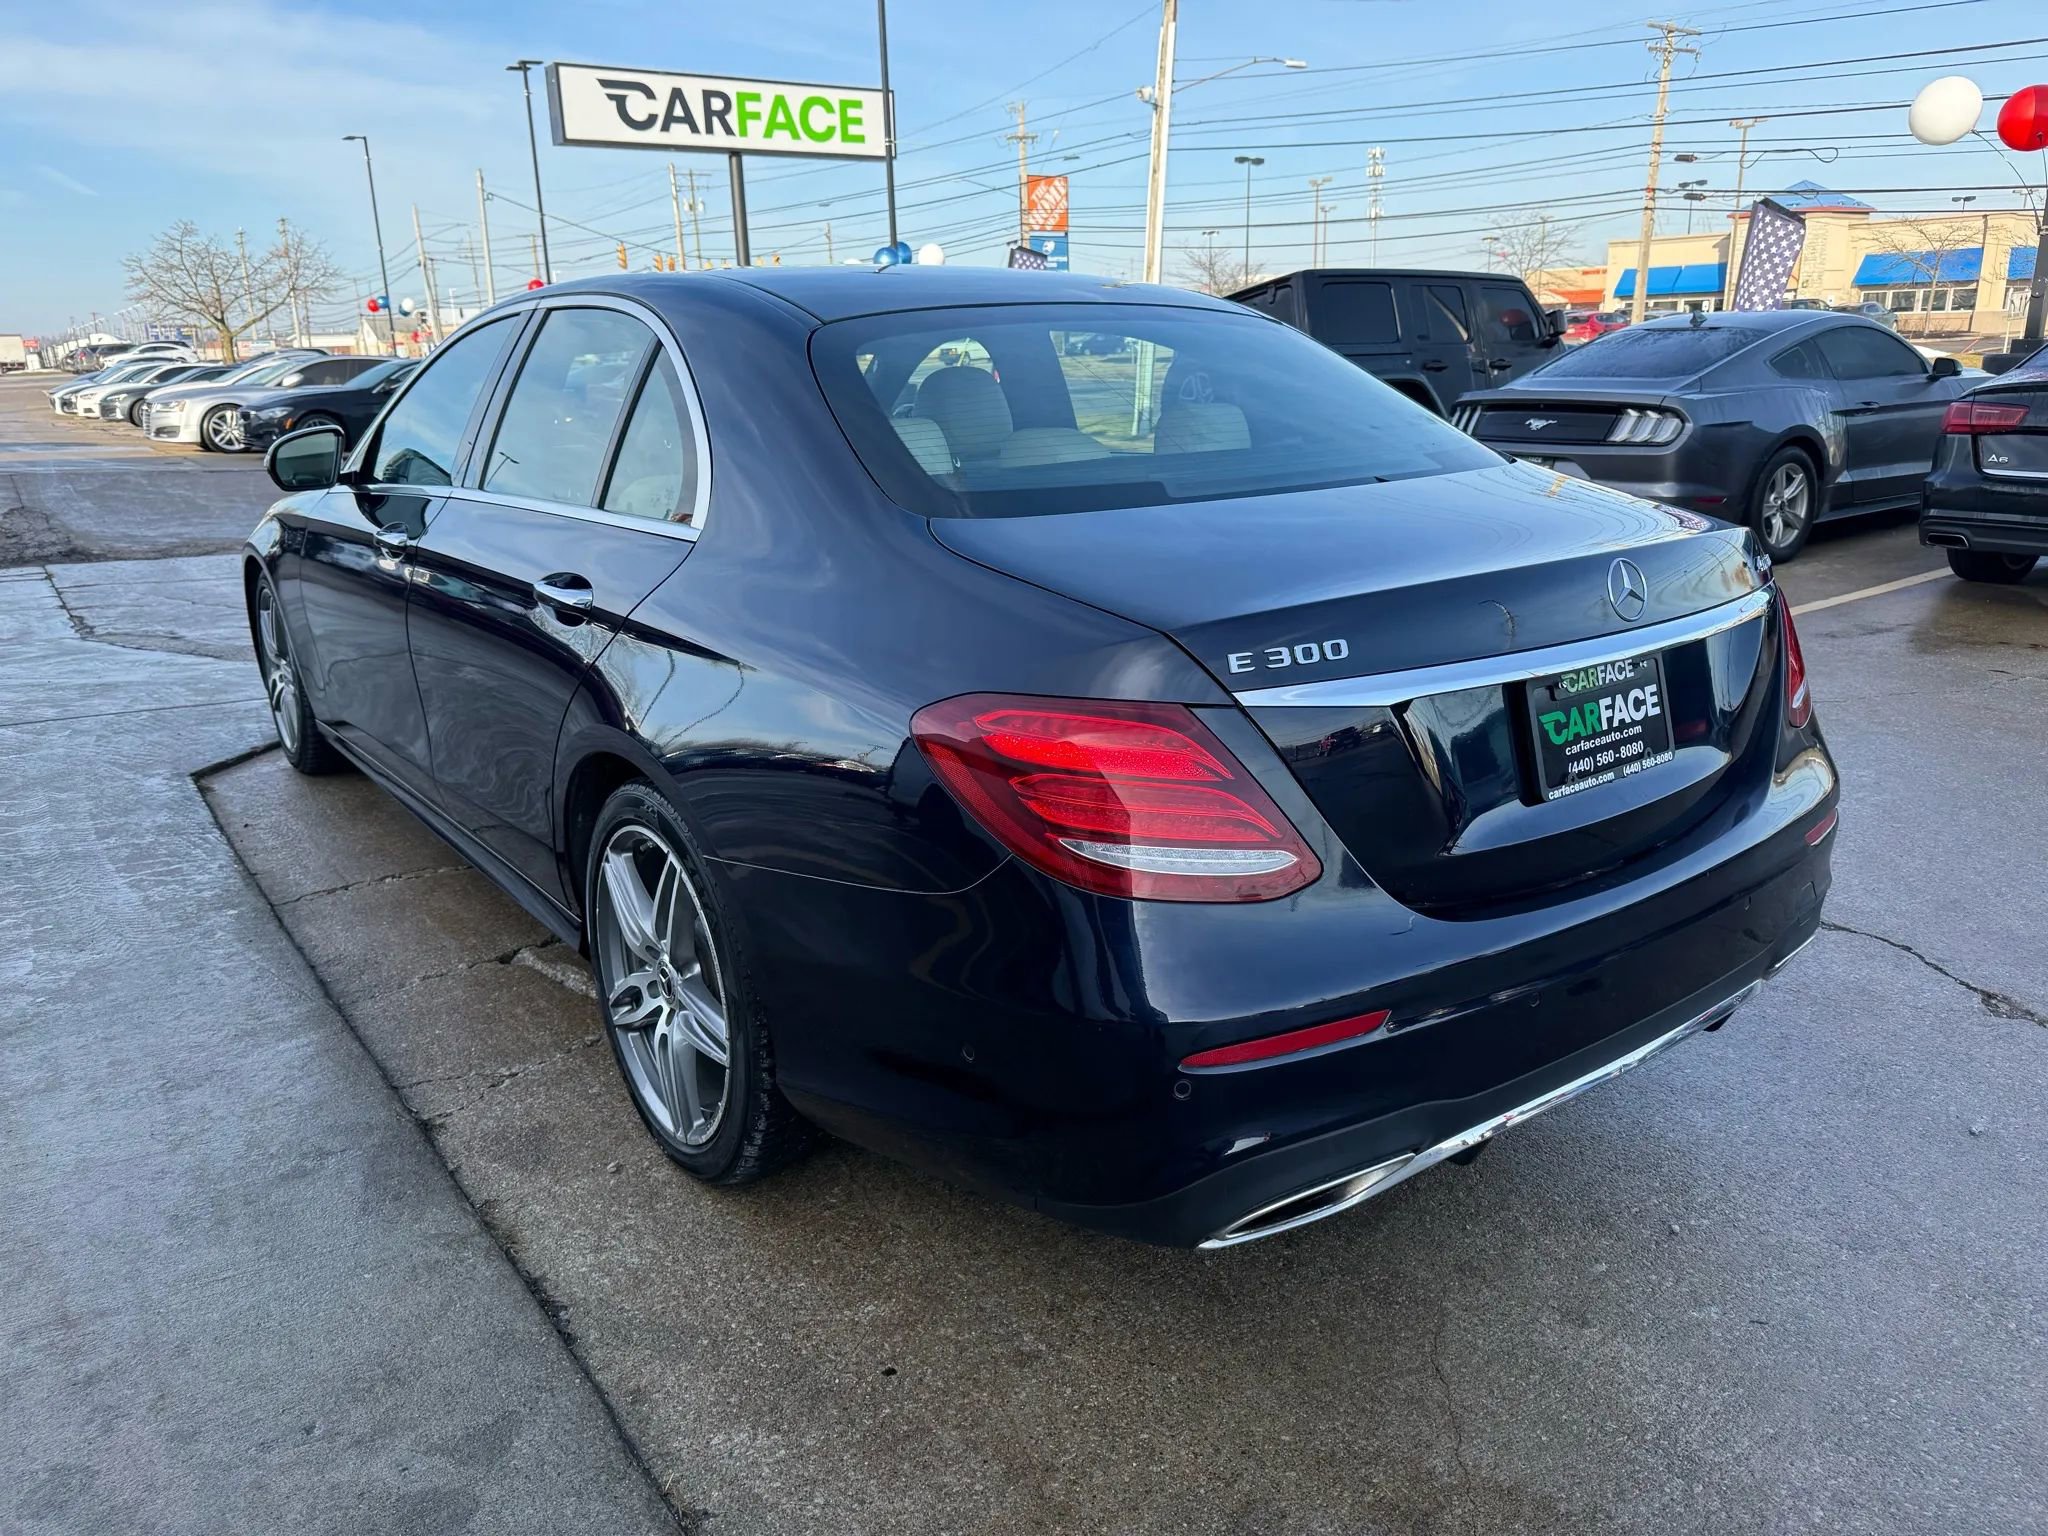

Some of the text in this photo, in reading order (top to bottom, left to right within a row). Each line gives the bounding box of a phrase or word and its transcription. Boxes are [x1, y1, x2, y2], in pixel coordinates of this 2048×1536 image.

[595, 78, 866, 144] CARFACE
[1987, 453, 2009, 464] A6
[1227, 638, 1349, 674] E 300
[1561, 659, 1635, 693] CARFACE
[1538, 683, 1661, 745] CARFACE
[1565, 725, 1642, 756] carfaceauto.com
[1548, 751, 1673, 800] carfaceauto.com (440) 560-8080
[1568, 756, 1594, 775] (440)
